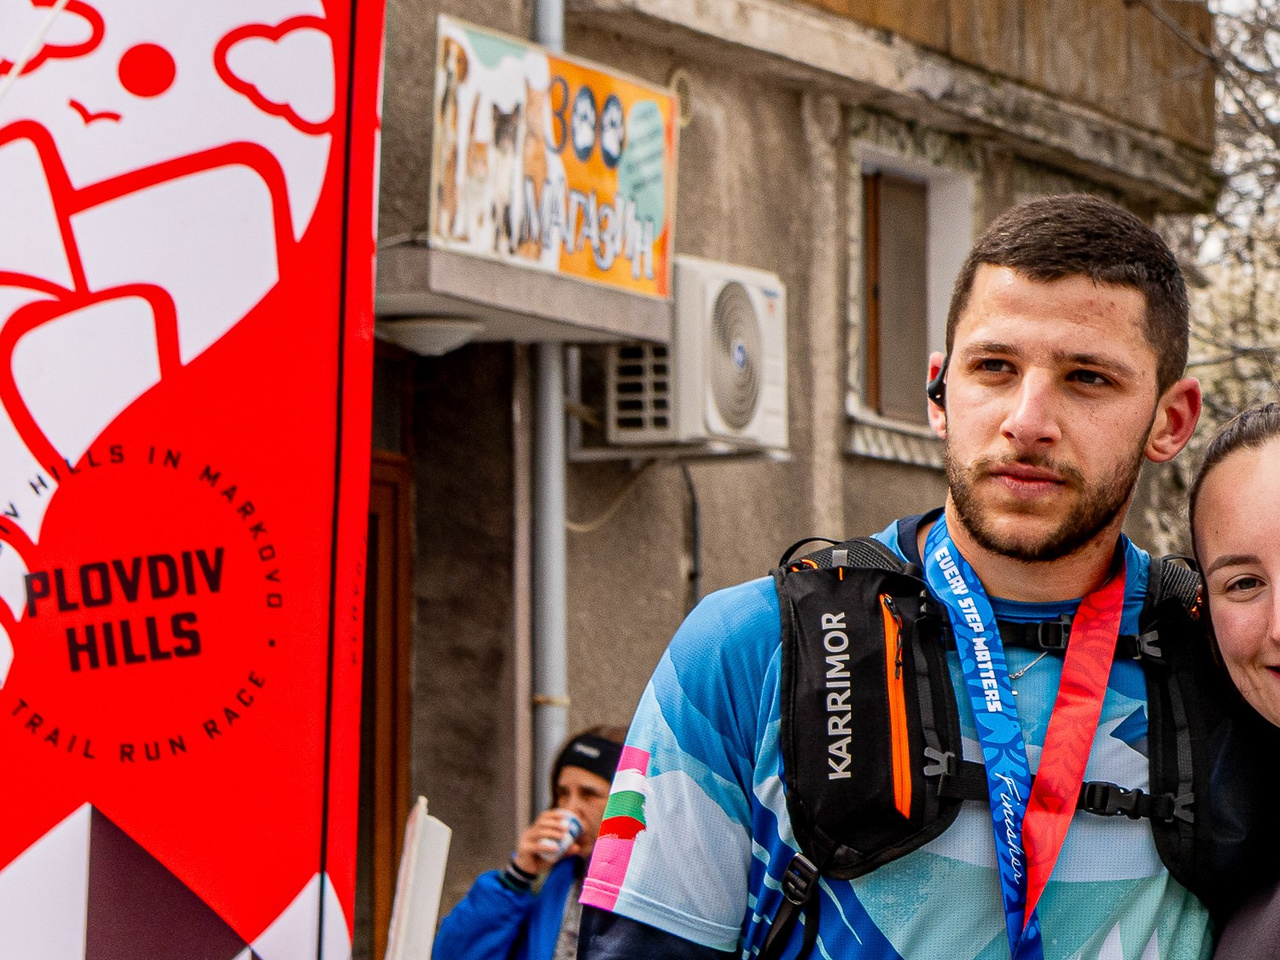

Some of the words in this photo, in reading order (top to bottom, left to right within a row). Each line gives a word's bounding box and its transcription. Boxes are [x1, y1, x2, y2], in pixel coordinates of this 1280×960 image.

[24, 546, 225, 618] PLOVDIV
[28, 444, 125, 496] HILLS
[148, 446, 181, 469] IN
[199, 465, 283, 608] MARKOVO
[66, 612, 202, 672] HILLS
[934, 546, 969, 599] EVERY
[957, 596, 984, 633] STEP
[972, 637, 1003, 713] MATTERS
[12, 699, 95, 759] TRAIL
[120, 735, 187, 763] RUN
[203, 671, 266, 739] RACE
[821, 612, 852, 781] KARRIMOR
